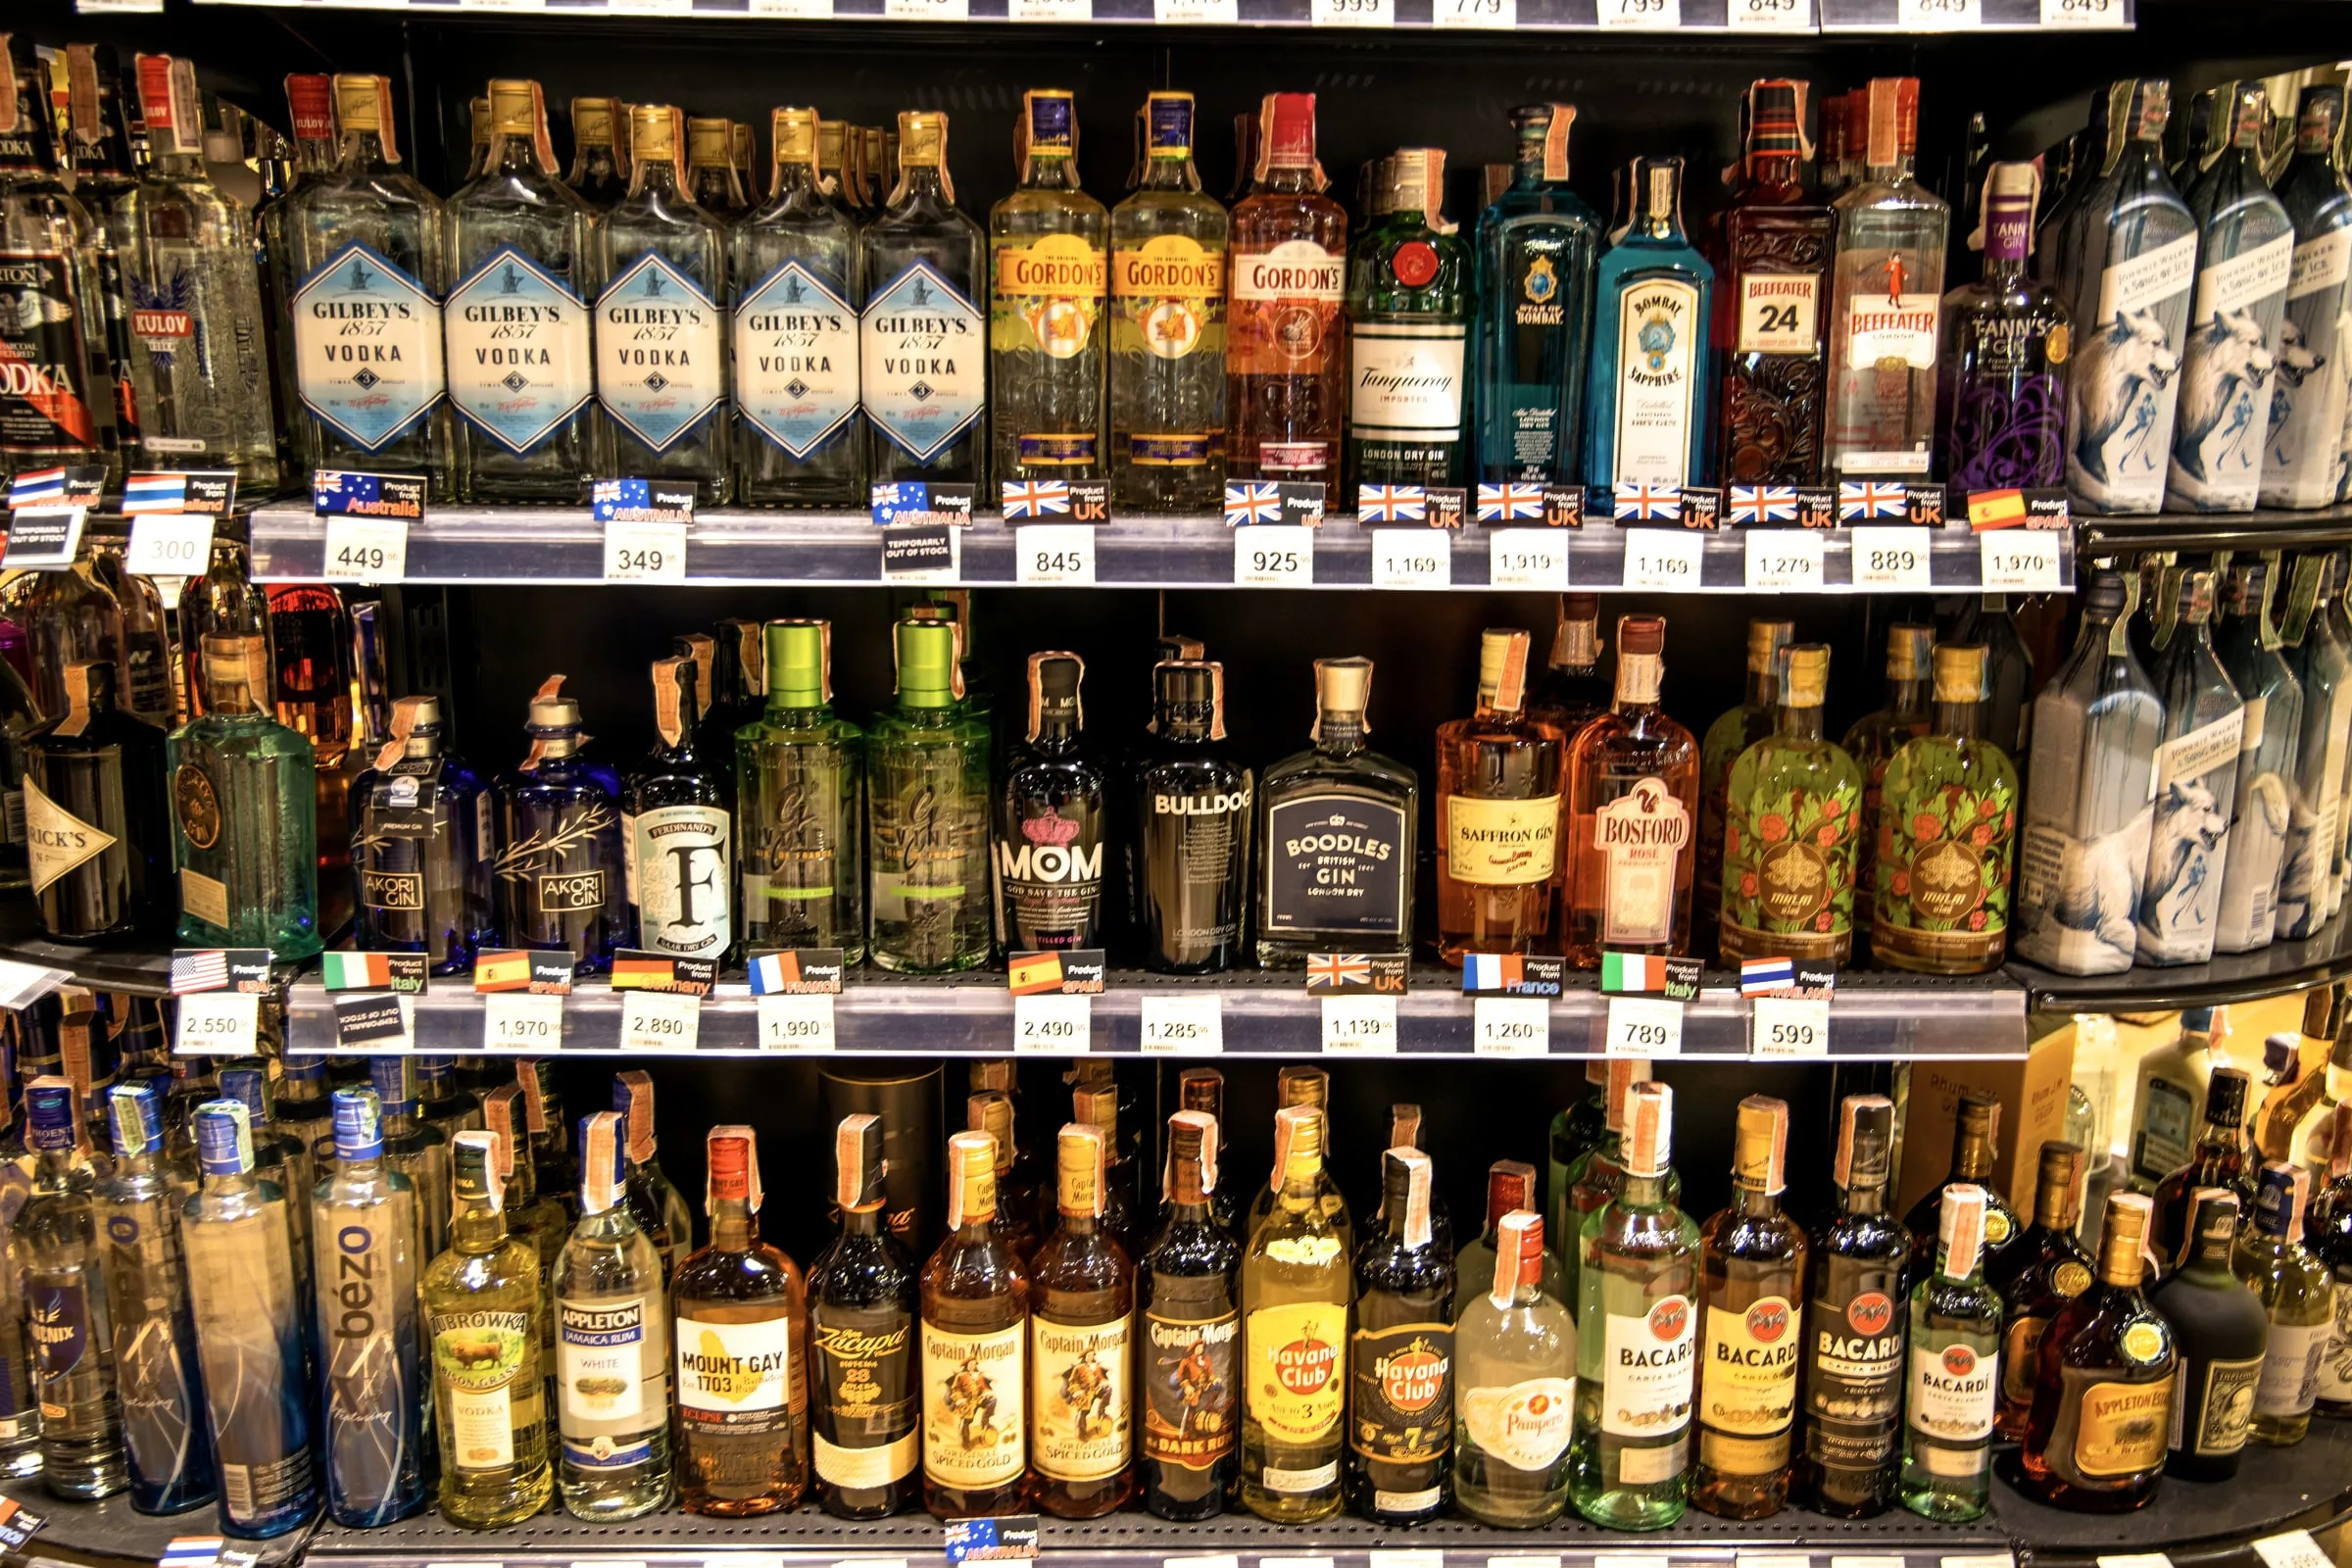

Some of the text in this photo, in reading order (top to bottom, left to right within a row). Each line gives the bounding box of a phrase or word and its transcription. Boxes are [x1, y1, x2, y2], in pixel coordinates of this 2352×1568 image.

[1017, 259, 1102, 284] GORDON'S
[1128, 261, 1215, 286] GORDON'S
[1253, 265, 1339, 290] GORDON'S
[1749, 281, 1812, 298] BEEFEATER
[313, 302, 411, 318] GILBEY'S
[466, 305, 561, 322] GILBEY'S
[1634, 296, 1684, 318] BOMBAY
[135, 314, 187, 333] KULOV
[610, 308, 701, 325] GILBEY'S
[750, 316, 842, 332] GILBEY'S
[1517, 313, 1564, 324] BOMBAY
[1759, 305, 1799, 332] 24
[1851, 313, 1935, 335] BEEFEATER
[339, 320, 388, 336] 1857
[490, 323, 538, 339] 1857
[875, 318, 966, 334] GILBEY'S
[1973, 318, 2047, 338] TANN'S
[325, 345, 402, 362] VODKA
[476, 349, 551, 365] VODKA
[619, 349, 690, 367] VODKA
[760, 357, 831, 372] VODKA
[884, 358, 956, 374] VODKA
[0, 365, 75, 394] ODKA
[1360, 367, 1452, 392] Tanqueray
[1629, 367, 1682, 387] SAPPHIRE
[1364, 449, 1444, 461] LONDON DRY GIN
[192, 481, 227, 491] Product
[346, 496, 420, 516] Australia
[612, 507, 693, 522] AUSTRALIA
[1074, 503, 1106, 520] UK
[1911, 506, 1941, 524] UK
[892, 511, 971, 525] AUSTRALIA
[1429, 511, 1460, 529] UK
[1547, 509, 1578, 526] UK
[1684, 512, 1715, 529] UK
[1801, 511, 1833, 527] UK
[2026, 514, 2070, 529] SPAIN
[151, 540, 195, 560] 300
[886, 549, 905, 558] OUT
[919, 546, 949, 556] STOCK
[887, 537, 946, 549] TEMPORARILY
[337, 547, 385, 568] 449
[617, 549, 663, 570] 349
[1036, 552, 1081, 572] 845
[1252, 552, 1298, 571] 925
[1386, 557, 1437, 575] 1,169
[1499, 553, 1551, 571] 1,919
[1638, 557, 1689, 576] 1,169
[1759, 557, 1810, 575] 1,279
[1870, 550, 1915, 571] 889
[1992, 554, 2043, 571] 1,970
[1154, 789, 1250, 815] BULLDOG
[1461, 825, 1553, 843] SAFFRON GIN
[1606, 817, 1683, 845] BOSFORD
[1286, 834, 1393, 861] BOODLES
[1002, 840, 1103, 882] MOM
[1317, 856, 1355, 865] BRITISH
[366, 876, 414, 892] AKORI
[666, 837, 725, 929] F
[1316, 869, 1355, 885] GIN
[545, 877, 599, 896] AKORI
[1006, 885, 1025, 896] GOD
[1028, 887, 1053, 897] SAVE
[1081, 886, 1096, 896] GIN
[1308, 888, 1365, 897] LONDON DRY
[385, 892, 416, 906] GIN
[570, 892, 600, 906] GIN
[238, 980, 269, 993] USA
[391, 976, 423, 994] Italy
[528, 981, 570, 995] SPAIN
[640, 974, 711, 997] Germany
[786, 981, 841, 994] FRANCE
[1062, 980, 1102, 994] SPAIN
[1375, 974, 1403, 991] UK
[1506, 979, 1559, 994] France
[1665, 980, 1697, 1001] Italy
[1769, 987, 1835, 1001] THAILAND
[187, 1016, 236, 1033] 2,550
[344, 1019, 399, 1032] TEMPORARILY
[499, 1019, 549, 1038] 1,970
[633, 1016, 684, 1036] 2,890
[770, 1020, 820, 1040] 1,990
[1024, 1021, 1074, 1039] 2,490
[1149, 1022, 1197, 1039] 1,285
[1333, 1019, 1380, 1036] 1,139
[1485, 1023, 1533, 1039] 1,260
[1625, 1023, 1666, 1045] 789
[1771, 1024, 1813, 1044] 599
[334, 1225, 374, 1339] bézo
[563, 1307, 639, 1330] APPLETON
[565, 1330, 635, 1346] JAMAICA RUM
[1040, 1325, 1129, 1353] Captain Morgan
[1151, 1321, 1200, 1349] Captain
[926, 1334, 1015, 1361] Captain Morgan
[1267, 1343, 1340, 1364] Havana
[580, 1358, 619, 1369] WHITE
[682, 1351, 783, 1374] MOUNT GAY
[1374, 1356, 1448, 1380] Havana
[479, 1362, 518, 1388] GRASS
[698, 1375, 732, 1392] 1703
[1281, 1369, 1326, 1388] Club
[1923, 1372, 1989, 1394] BACARDÍ
[1392, 1380, 1436, 1399] Club
[458, 1406, 504, 1416] VODKA
[682, 1407, 722, 1423] ECLIPSE
[2094, 1395, 2151, 1418] APPLETON
[1506, 1412, 1563, 1438] Pampero
[1093, 1444, 1124, 1458] GOLD
[1158, 1440, 1205, 1454] DARK
[975, 1453, 1011, 1467] GOLD
[964, 1545, 1040, 1560] AUSTRALIA
